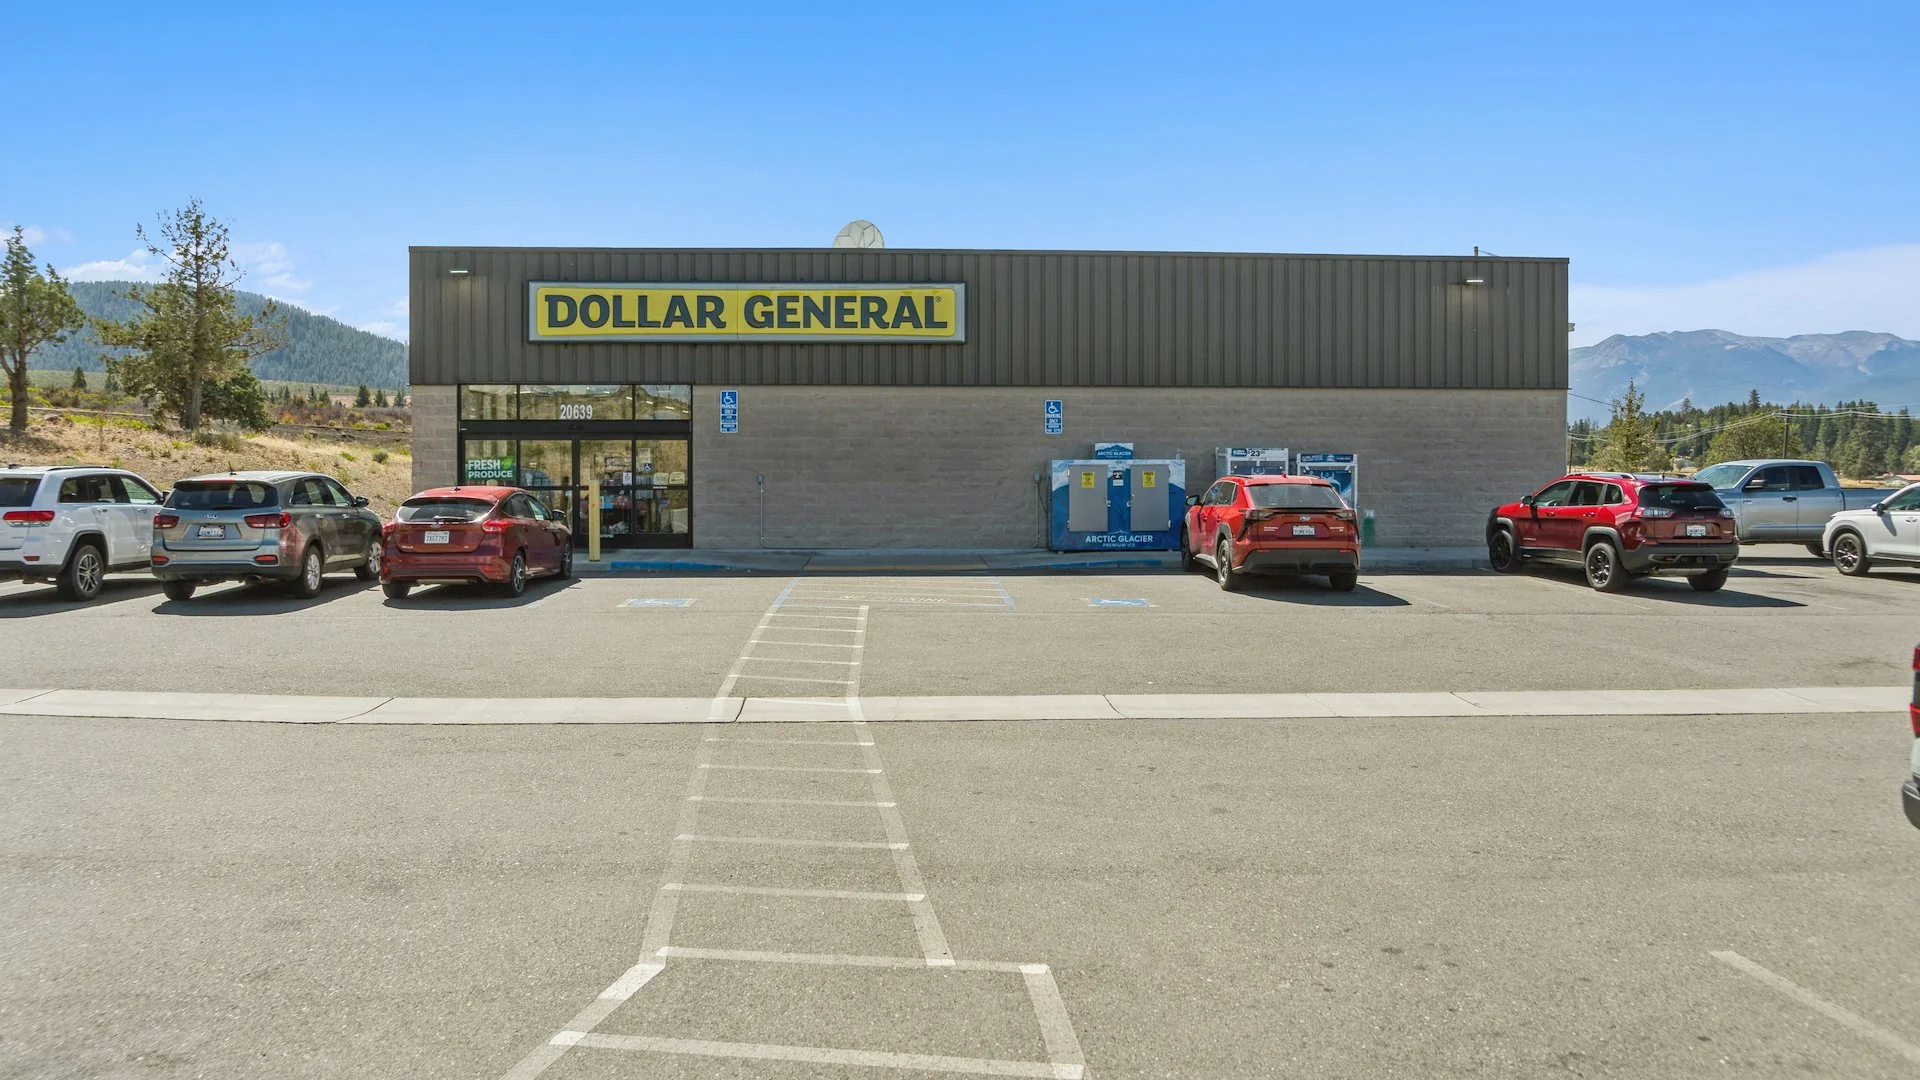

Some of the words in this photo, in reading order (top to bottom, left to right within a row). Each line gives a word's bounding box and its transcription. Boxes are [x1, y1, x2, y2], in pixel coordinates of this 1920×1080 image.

[544, 295, 727, 329] DOLLAR
[743, 294, 949, 330] GENERAL
[560, 404, 593, 420] 20639
[468, 460, 500, 470] FRESH
[468, 470, 513, 479] PRODUCE
[1085, 535, 1116, 543] ARCTIC
[1118, 535, 1154, 543] GLACIER
